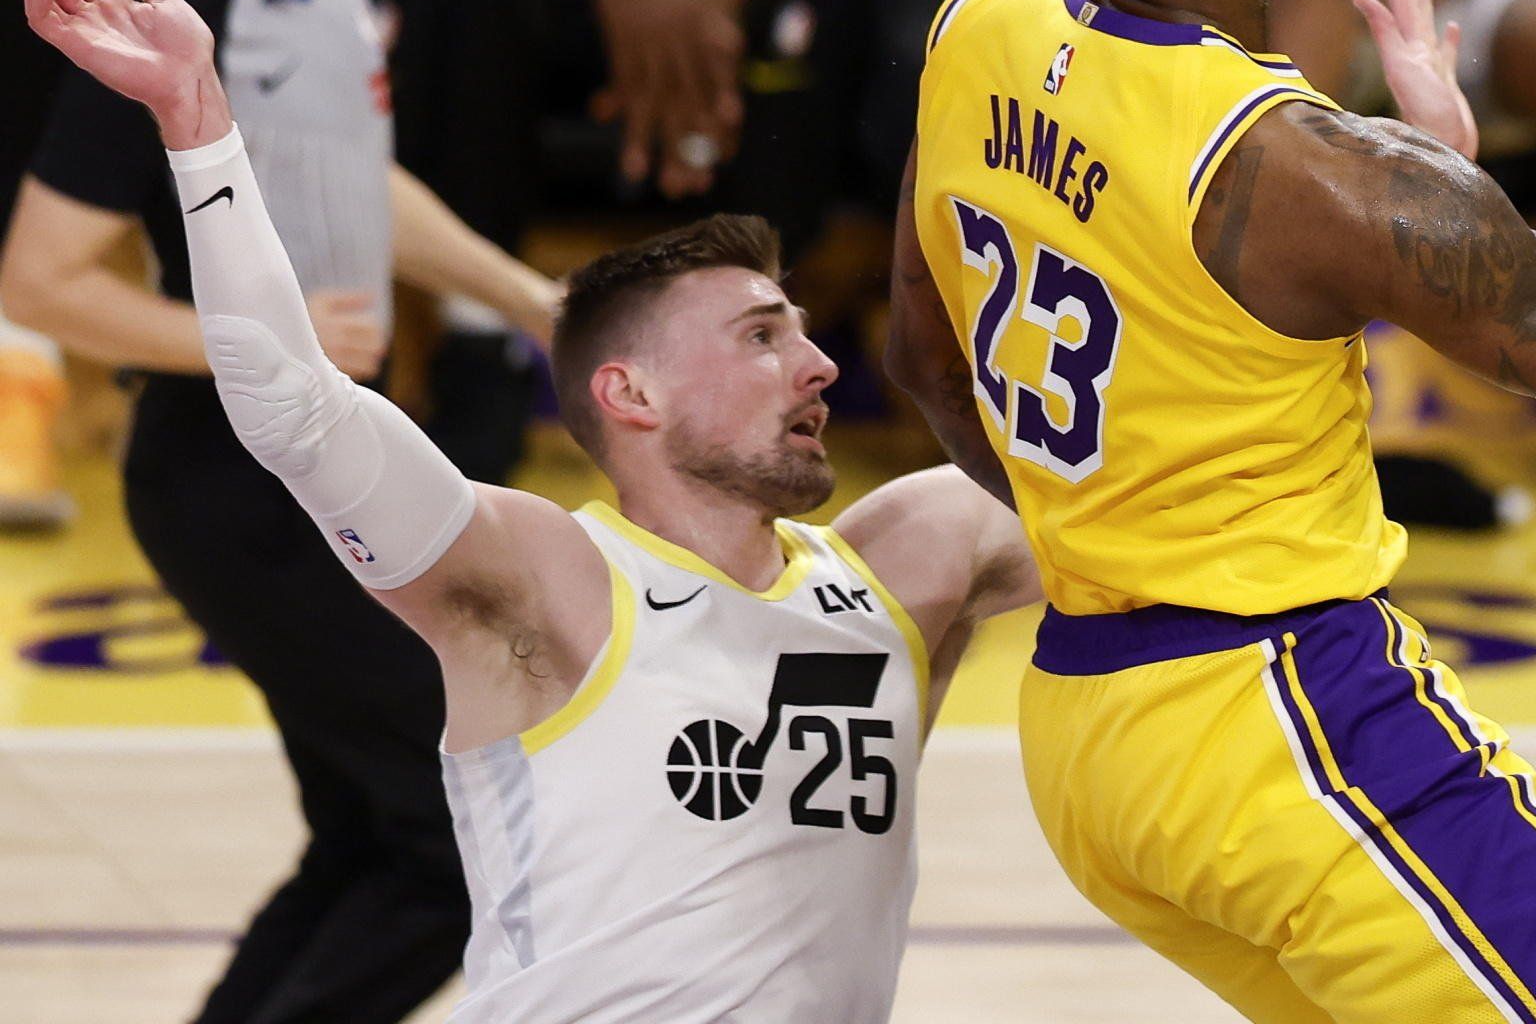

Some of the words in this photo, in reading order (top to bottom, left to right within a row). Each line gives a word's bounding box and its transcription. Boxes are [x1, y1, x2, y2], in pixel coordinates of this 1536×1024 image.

[984, 94, 1109, 223] JAMES
[948, 194, 1123, 484] 23
[789, 715, 897, 835] 25
